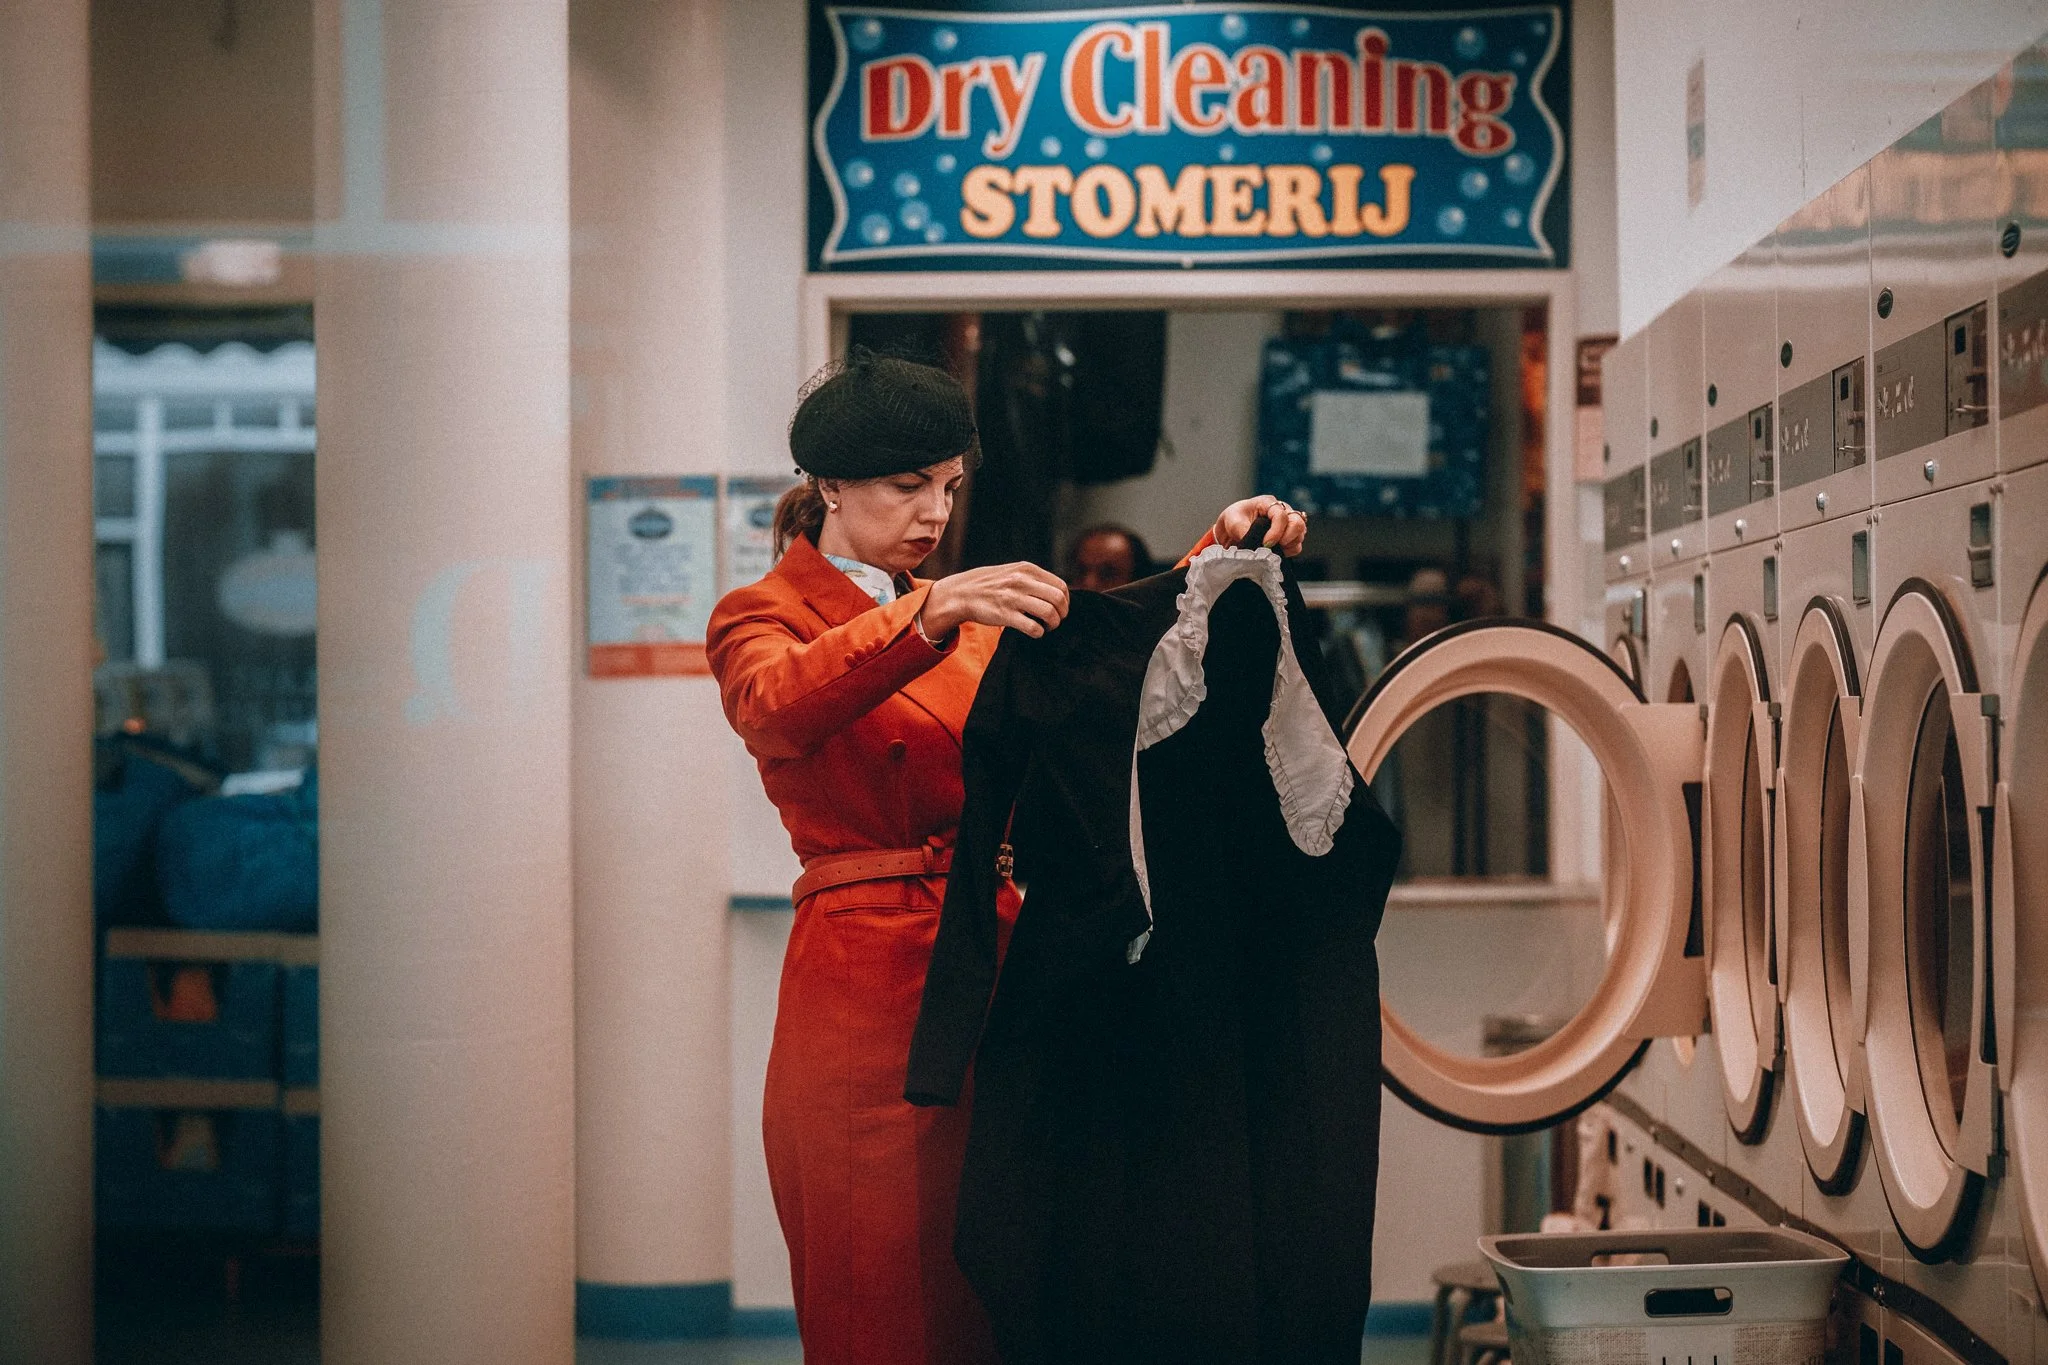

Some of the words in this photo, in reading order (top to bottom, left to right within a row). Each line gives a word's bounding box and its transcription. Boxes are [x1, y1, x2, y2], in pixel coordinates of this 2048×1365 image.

[860, 53, 1047, 160] Dry
[1061, 21, 1517, 157] Cleaning
[960, 164, 1416, 238] STOMERIJ
